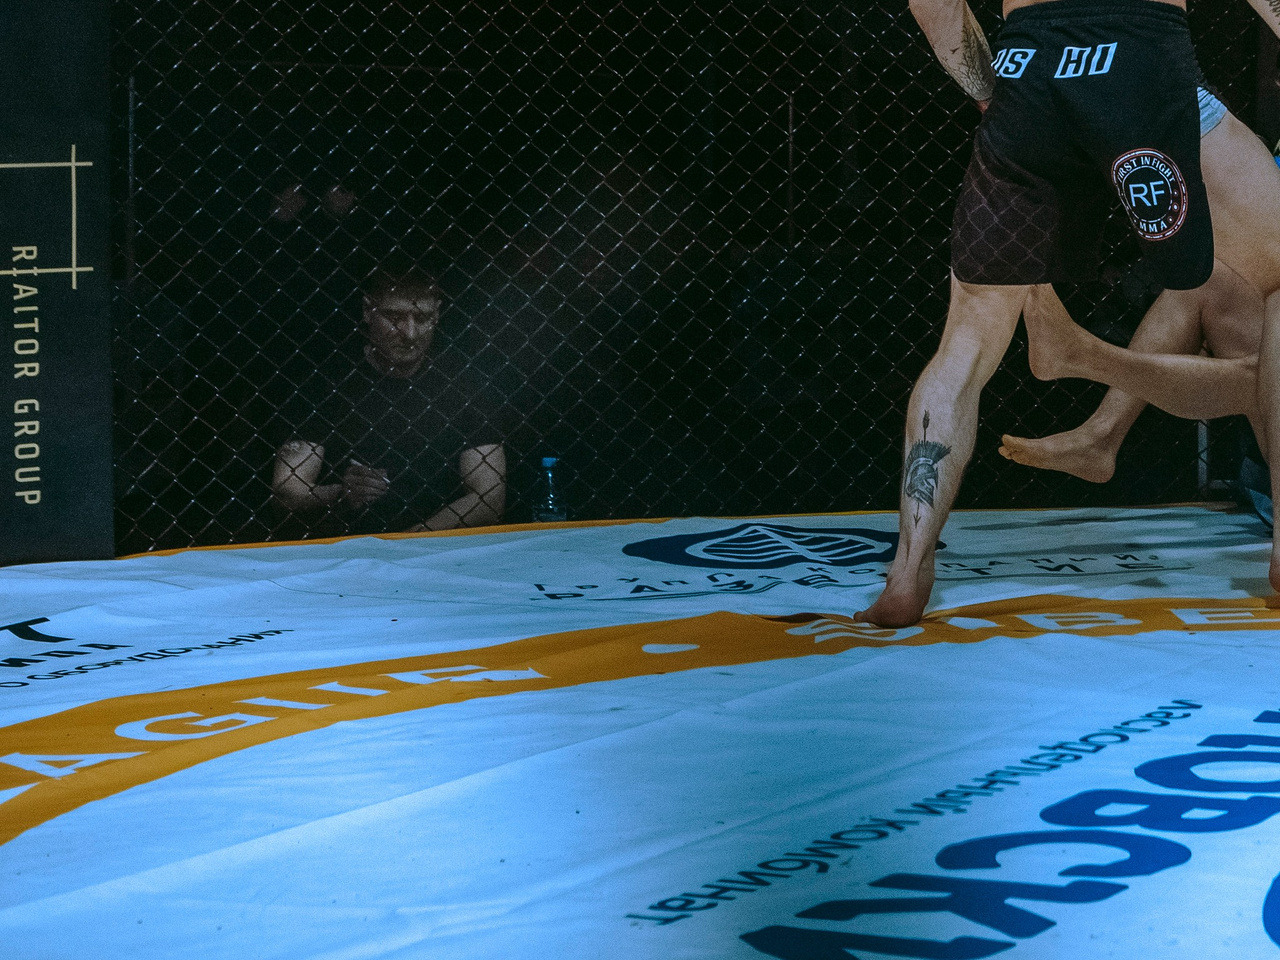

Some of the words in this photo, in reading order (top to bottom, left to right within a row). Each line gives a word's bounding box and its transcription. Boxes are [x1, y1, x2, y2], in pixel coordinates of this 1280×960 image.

[1117, 158, 1137, 183] FIRST
[1141, 156, 1150, 165] IN
[1152, 158, 1175, 182] FIGHT
[1129, 180, 1165, 207] RF
[1140, 220, 1168, 233] MMA
[13, 398, 42, 506] GROUP
[544, 562, 1164, 600] РАЗВТИЕ
